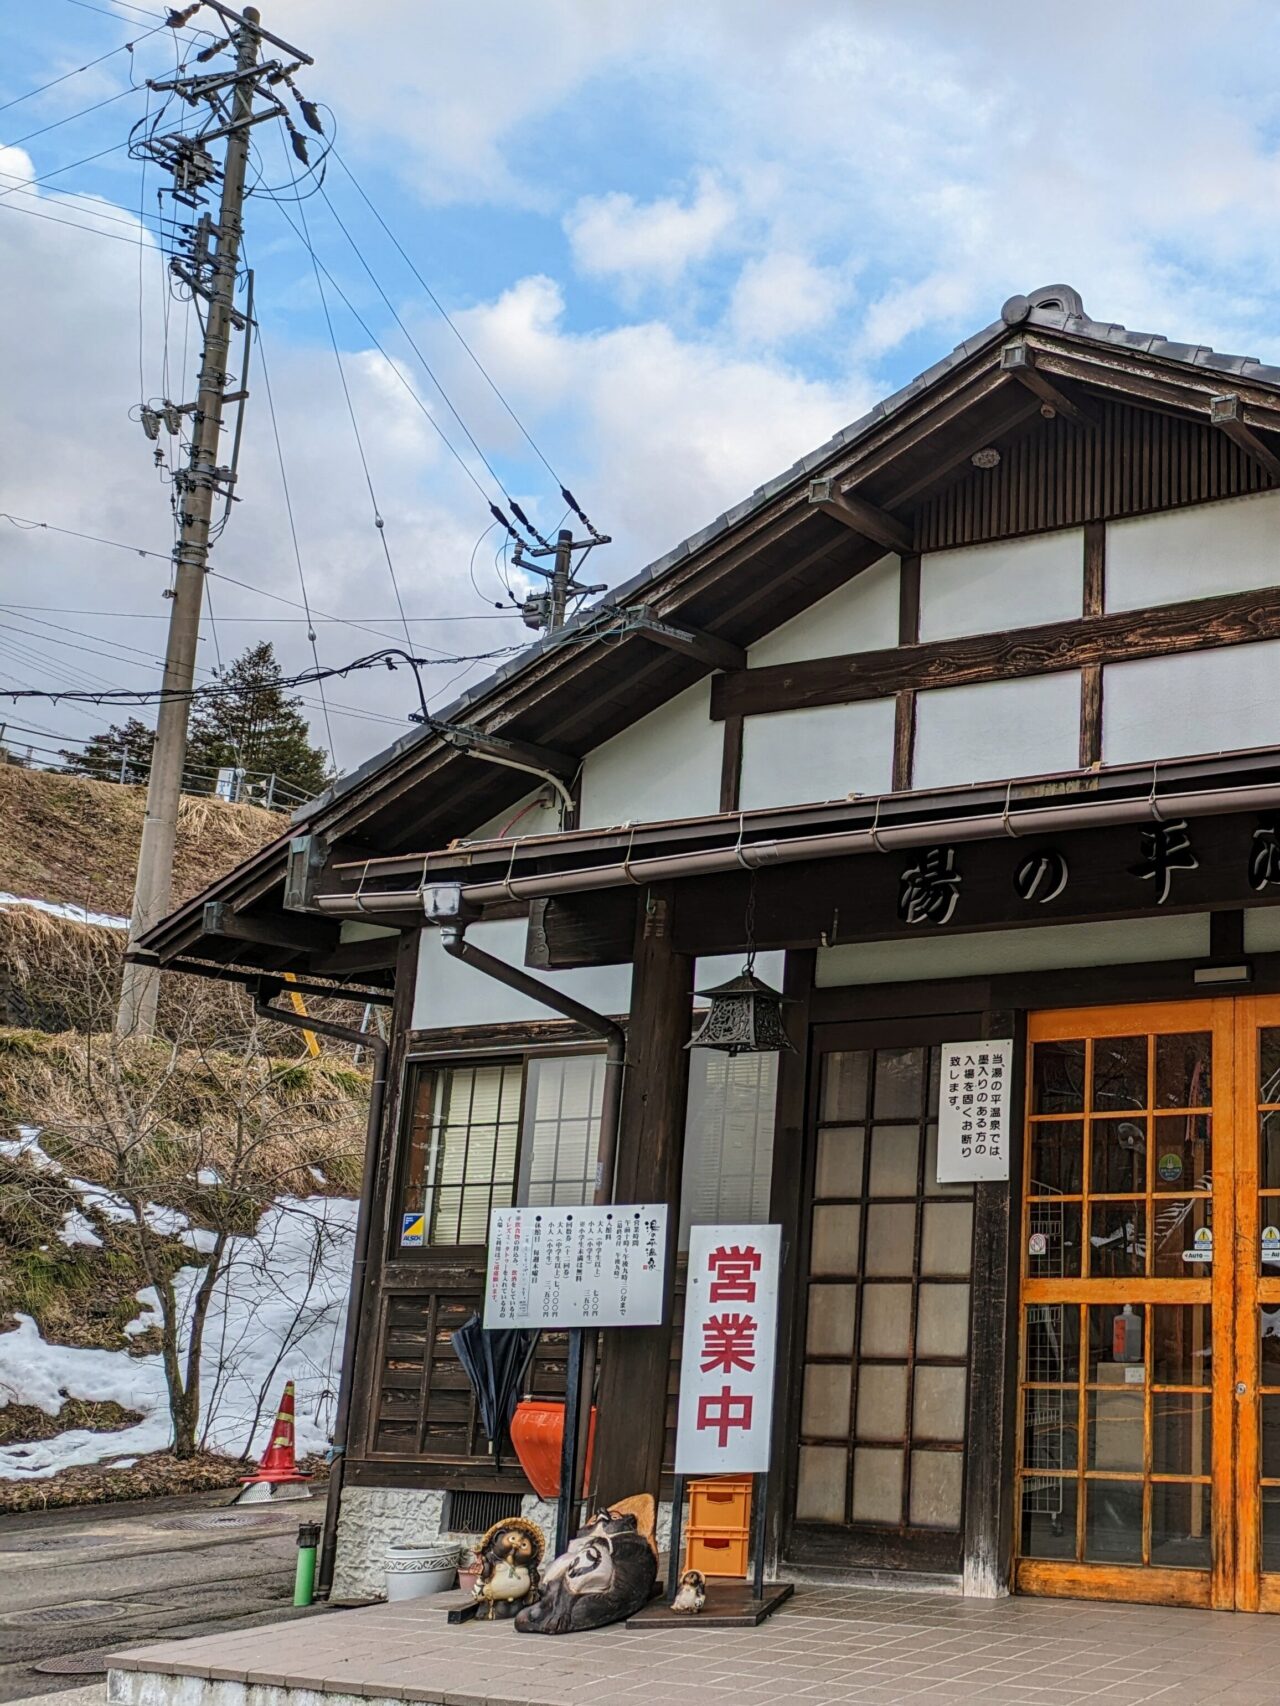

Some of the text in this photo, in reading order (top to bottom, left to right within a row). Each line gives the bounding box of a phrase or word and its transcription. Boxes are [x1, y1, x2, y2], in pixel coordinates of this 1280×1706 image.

[948, 1056, 961, 1111] 致します。
[961, 1055, 975, 1158] 入場を固くお断り
[975, 1054, 990, 1155] 墨入りのある方の
[989, 1054, 1005, 1161] 当、湯の平温泉では、
[695, 1244, 762, 1449] 営業中
